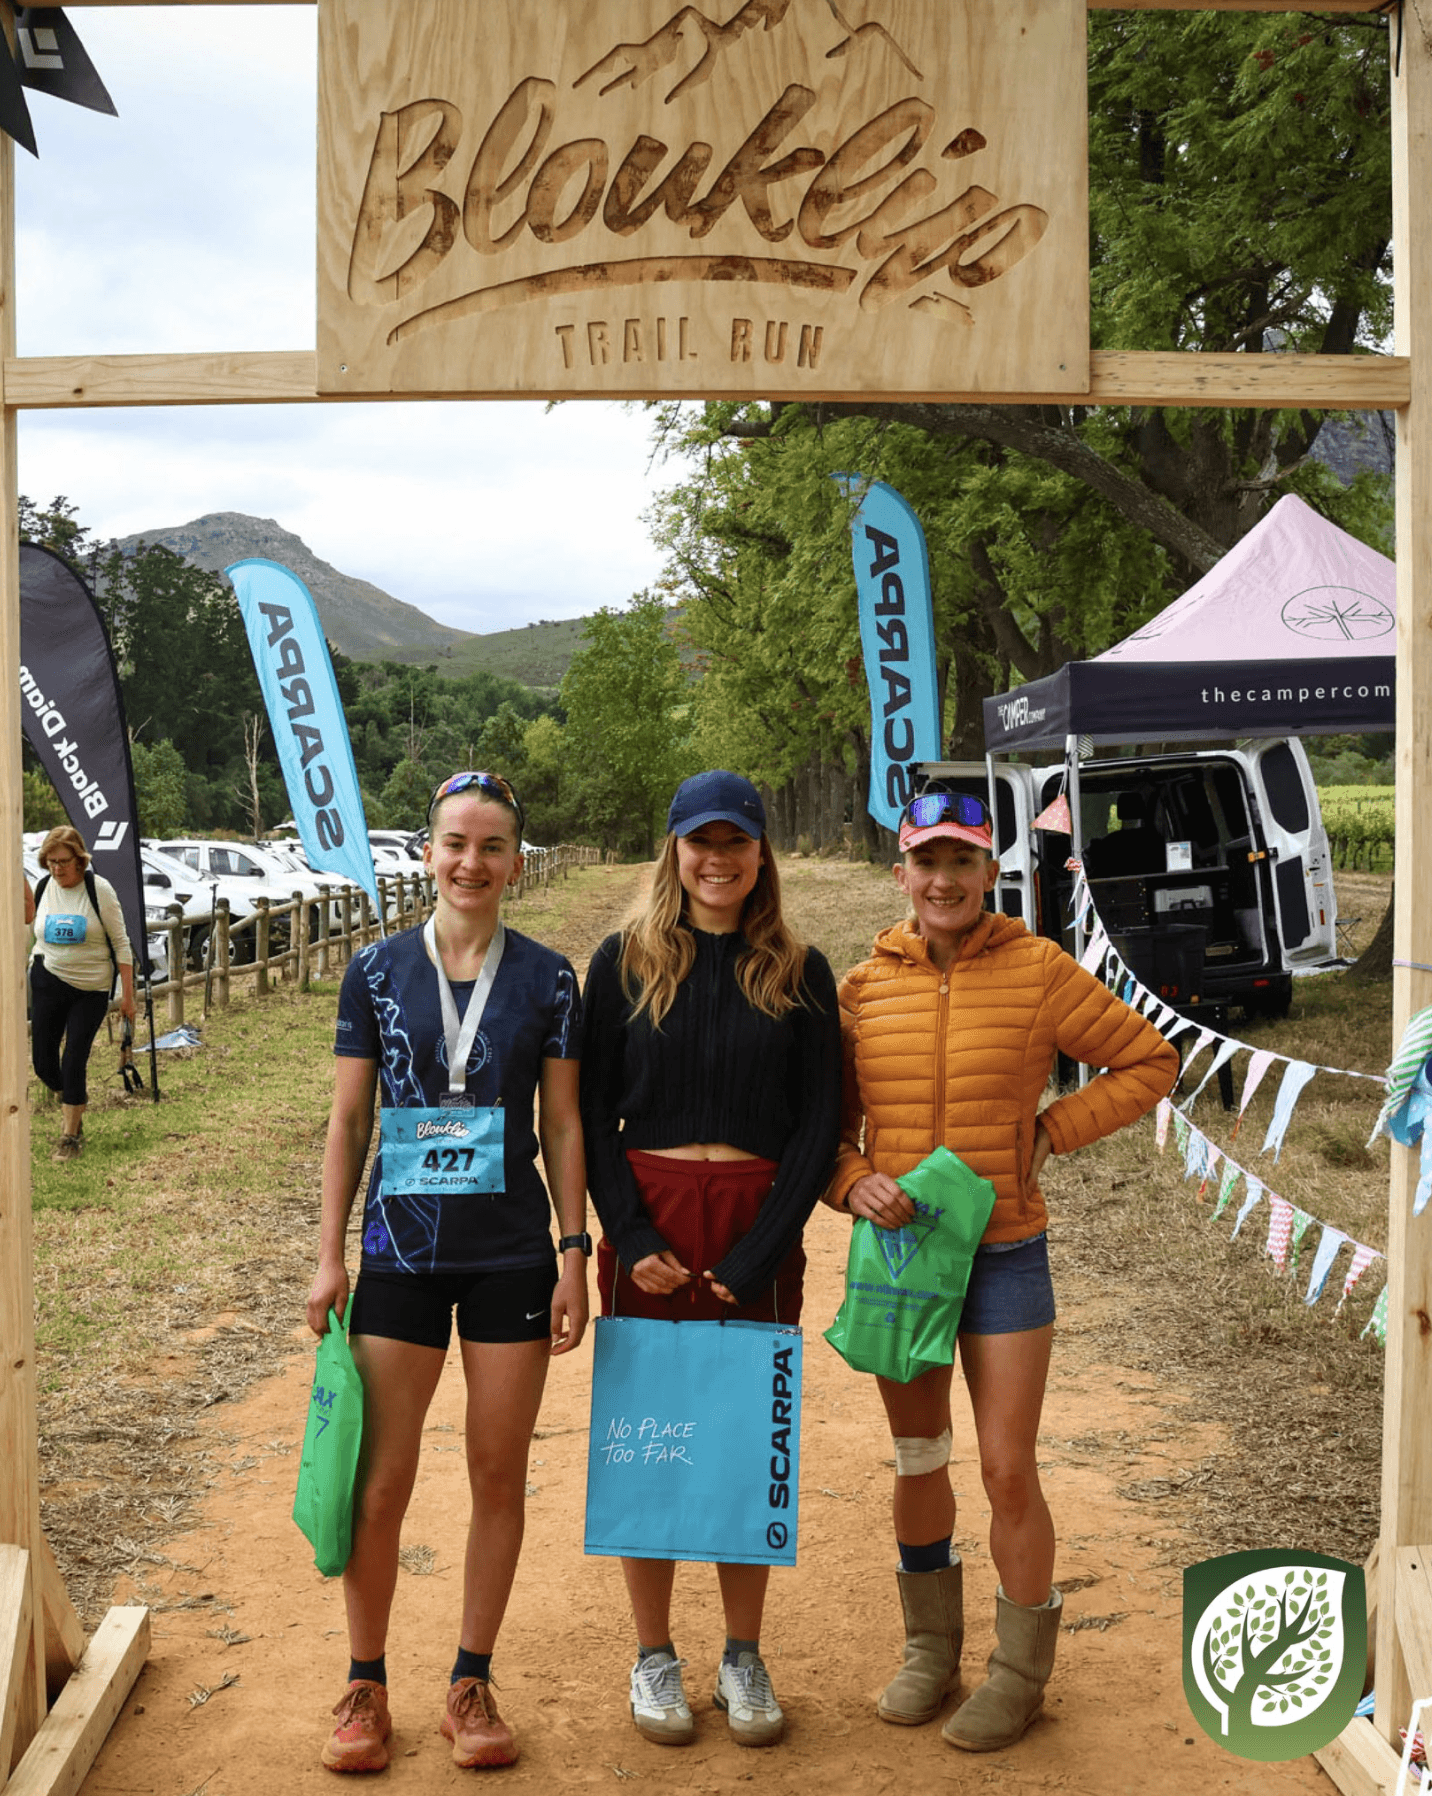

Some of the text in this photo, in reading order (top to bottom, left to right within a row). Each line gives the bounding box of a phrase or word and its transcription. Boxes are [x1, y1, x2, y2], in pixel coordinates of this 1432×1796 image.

[347, 75, 1050, 313] Blouklip
[555, 315, 824, 370] TRAIL RUN
[1200, 684, 1391, 703] thecampercom
[1003, 696, 1029, 732] CAMPER
[54, 927, 74, 937] 378
[421, 1147, 476, 1172] 427
[419, 1176, 479, 1186] SCARPA
[768, 1346, 794, 1511] SCARPA
